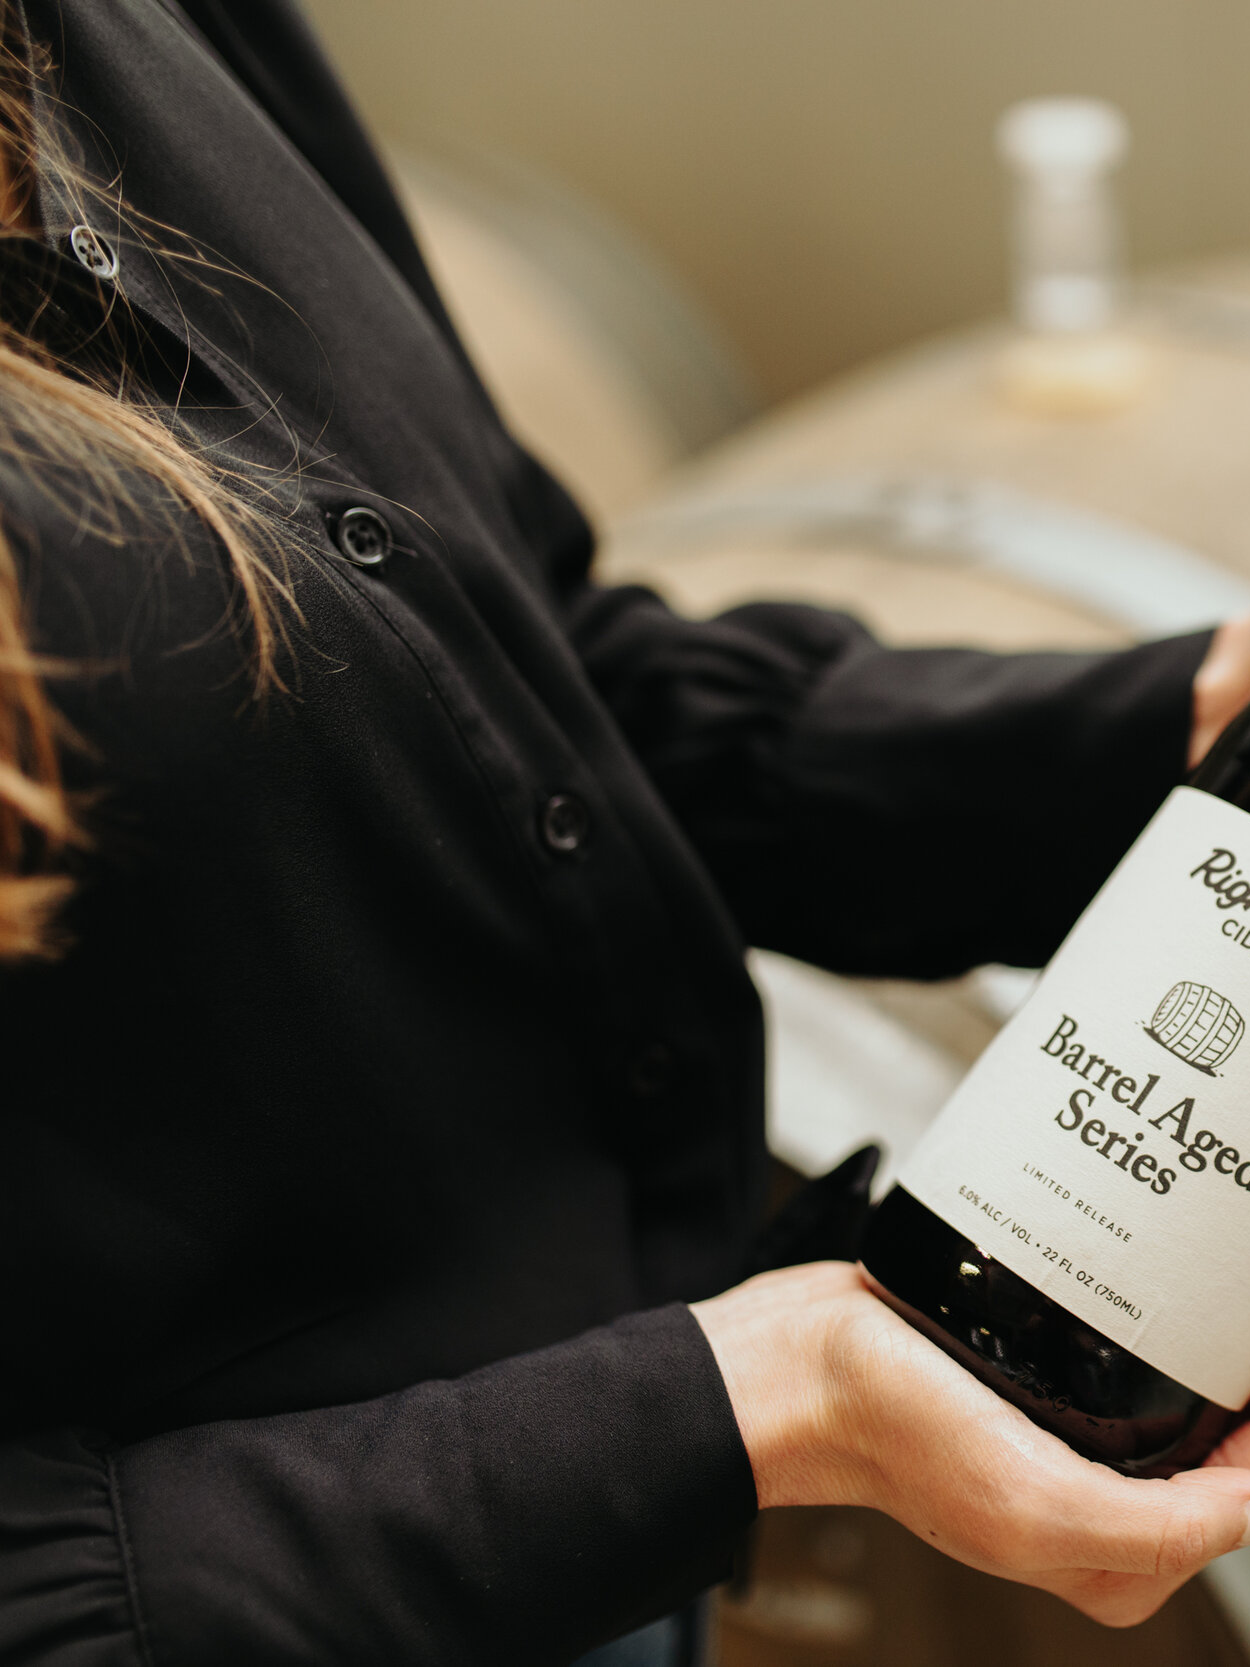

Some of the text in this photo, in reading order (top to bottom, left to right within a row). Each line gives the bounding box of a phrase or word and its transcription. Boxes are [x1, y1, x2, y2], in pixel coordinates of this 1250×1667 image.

[1040, 1014, 1160, 1115] Barrel
[1054, 1088, 1177, 1195] Series
[958, 1184, 981, 1207] 6.0%
[980, 1202, 1003, 1222] ALC
[1012, 1222, 1032, 1245] VOL
[1042, 1247, 1059, 1262] 22
[1059, 1257, 1073, 1274] FL
[1076, 1270, 1095, 1287] OZ
[1094, 1283, 1142, 1321] (750ML)
[1023, 1163, 1133, 1243] LIMITED RELEASE
